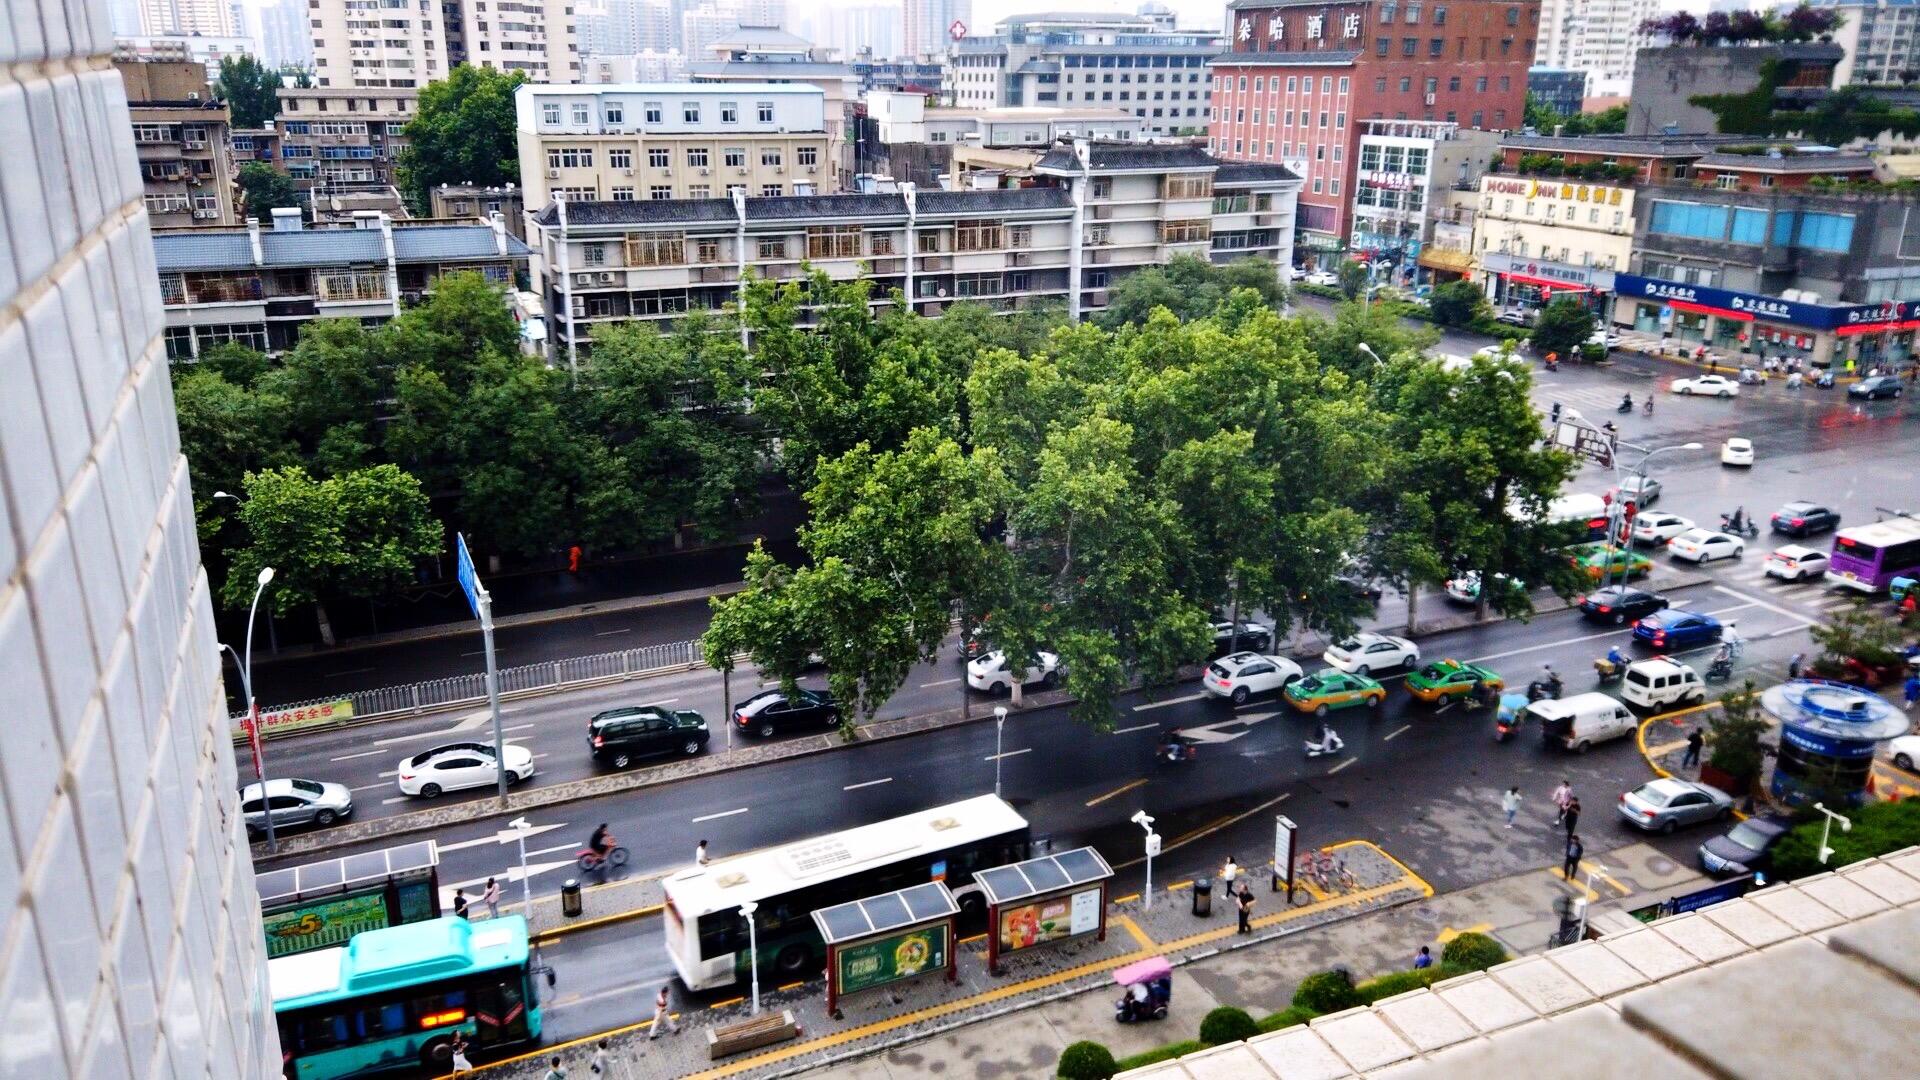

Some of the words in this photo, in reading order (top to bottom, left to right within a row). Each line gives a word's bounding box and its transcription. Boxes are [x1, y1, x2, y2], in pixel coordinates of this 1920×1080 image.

[1238, 13, 1360, 41] 朵哈酒店
[1487, 180, 1526, 195] HOME
